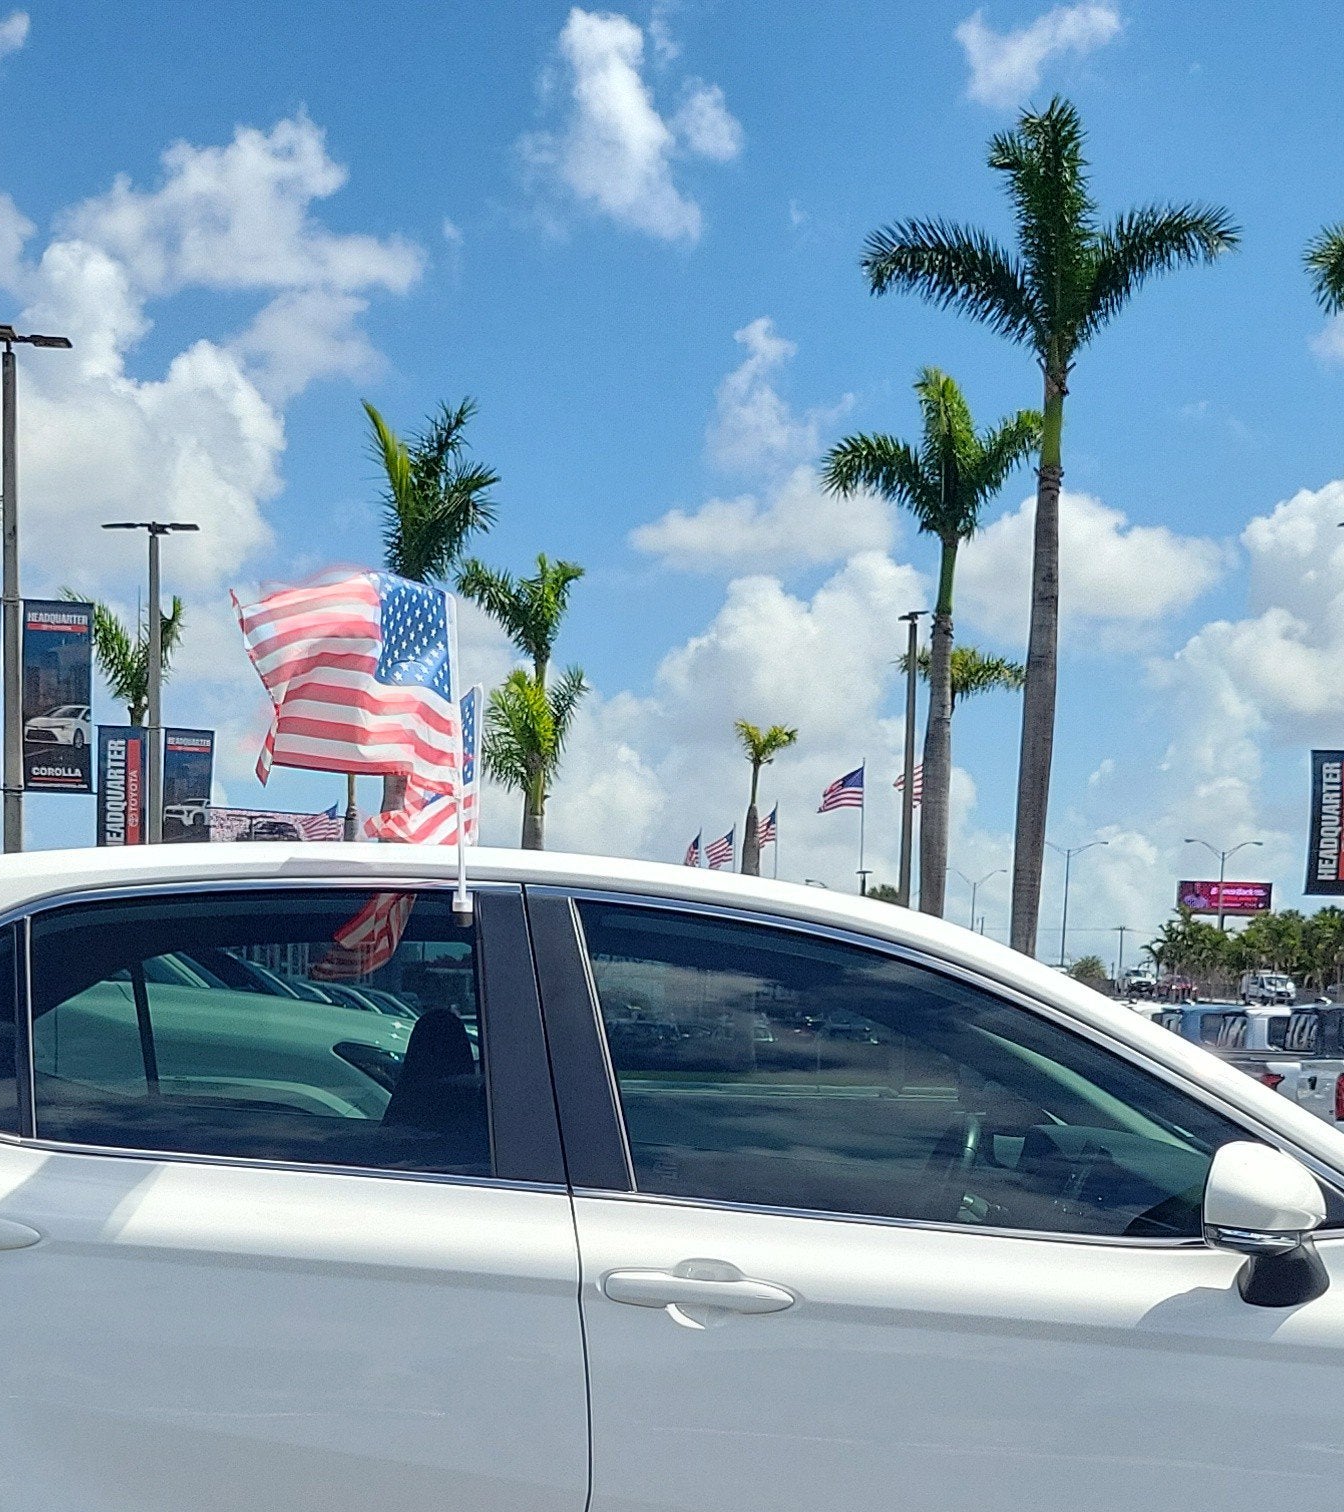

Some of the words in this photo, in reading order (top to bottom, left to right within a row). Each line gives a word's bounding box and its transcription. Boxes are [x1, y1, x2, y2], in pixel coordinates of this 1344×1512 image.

[31, 766, 82, 777] COROLLA
[129, 770, 138, 813] TOYOTA
[1317, 762, 1342, 881] HEADQUARTER
